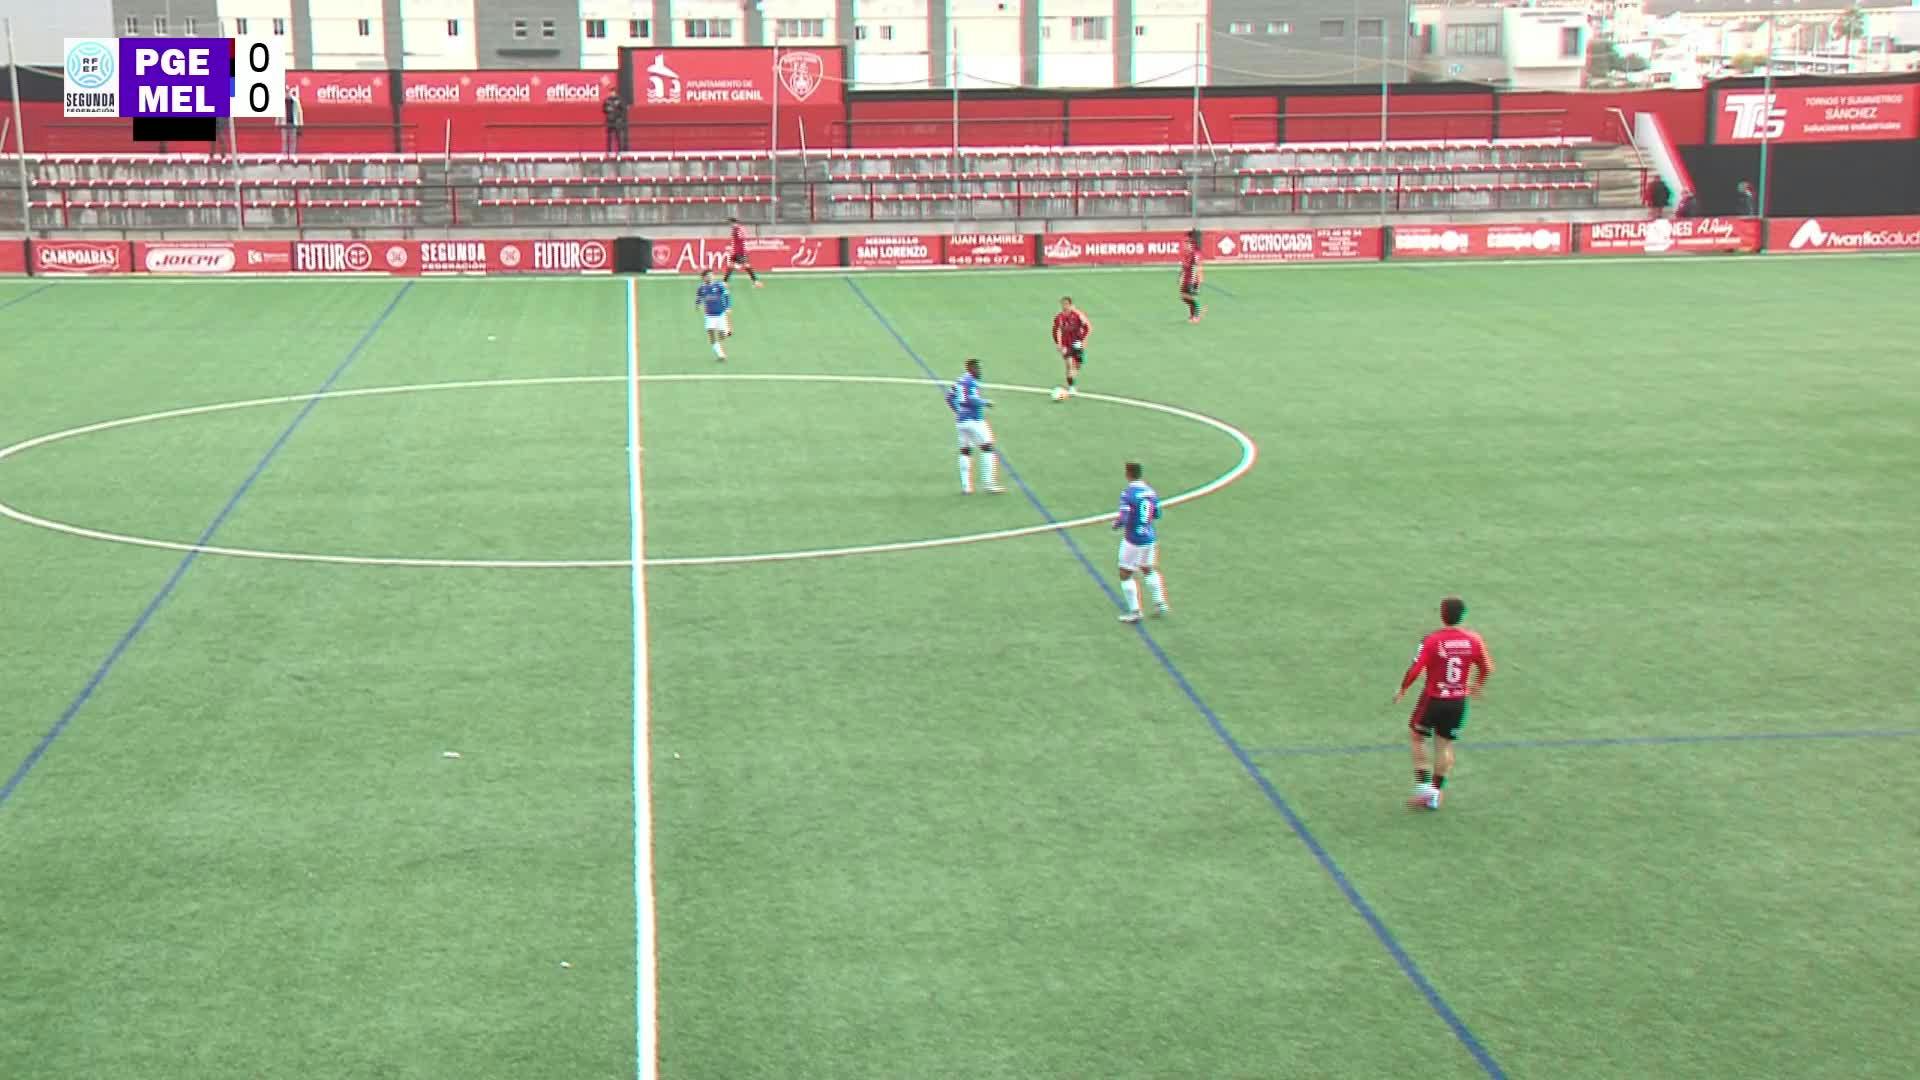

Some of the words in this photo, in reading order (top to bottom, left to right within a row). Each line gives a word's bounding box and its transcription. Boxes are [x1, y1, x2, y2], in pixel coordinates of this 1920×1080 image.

[317, 84, 372, 99] efficold
[405, 84, 460, 99] efficold
[475, 83, 530, 98] efficold
[546, 83, 600, 98] efficold
[686, 80, 742, 88] AYUNTAMIENTO
[686, 90, 730, 101] PUENTE
[733, 90, 764, 101] GENIL
[1824, 106, 1878, 120] SÁNCHEZ
[950, 235, 976, 245] JUAN
[1240, 233, 1313, 251] TECNOCASA
[41, 249, 114, 264] CAMPOARAS
[420, 243, 486, 261] SEGUNDA
[857, 246, 878, 258] SAN
[880, 246, 928, 257] LORENZO
[1085, 242, 1145, 256] HIERROS
[1147, 242, 1180, 255] RUIZ
[1140, 500, 1154, 524] 9
[1446, 657, 1462, 683] 6
